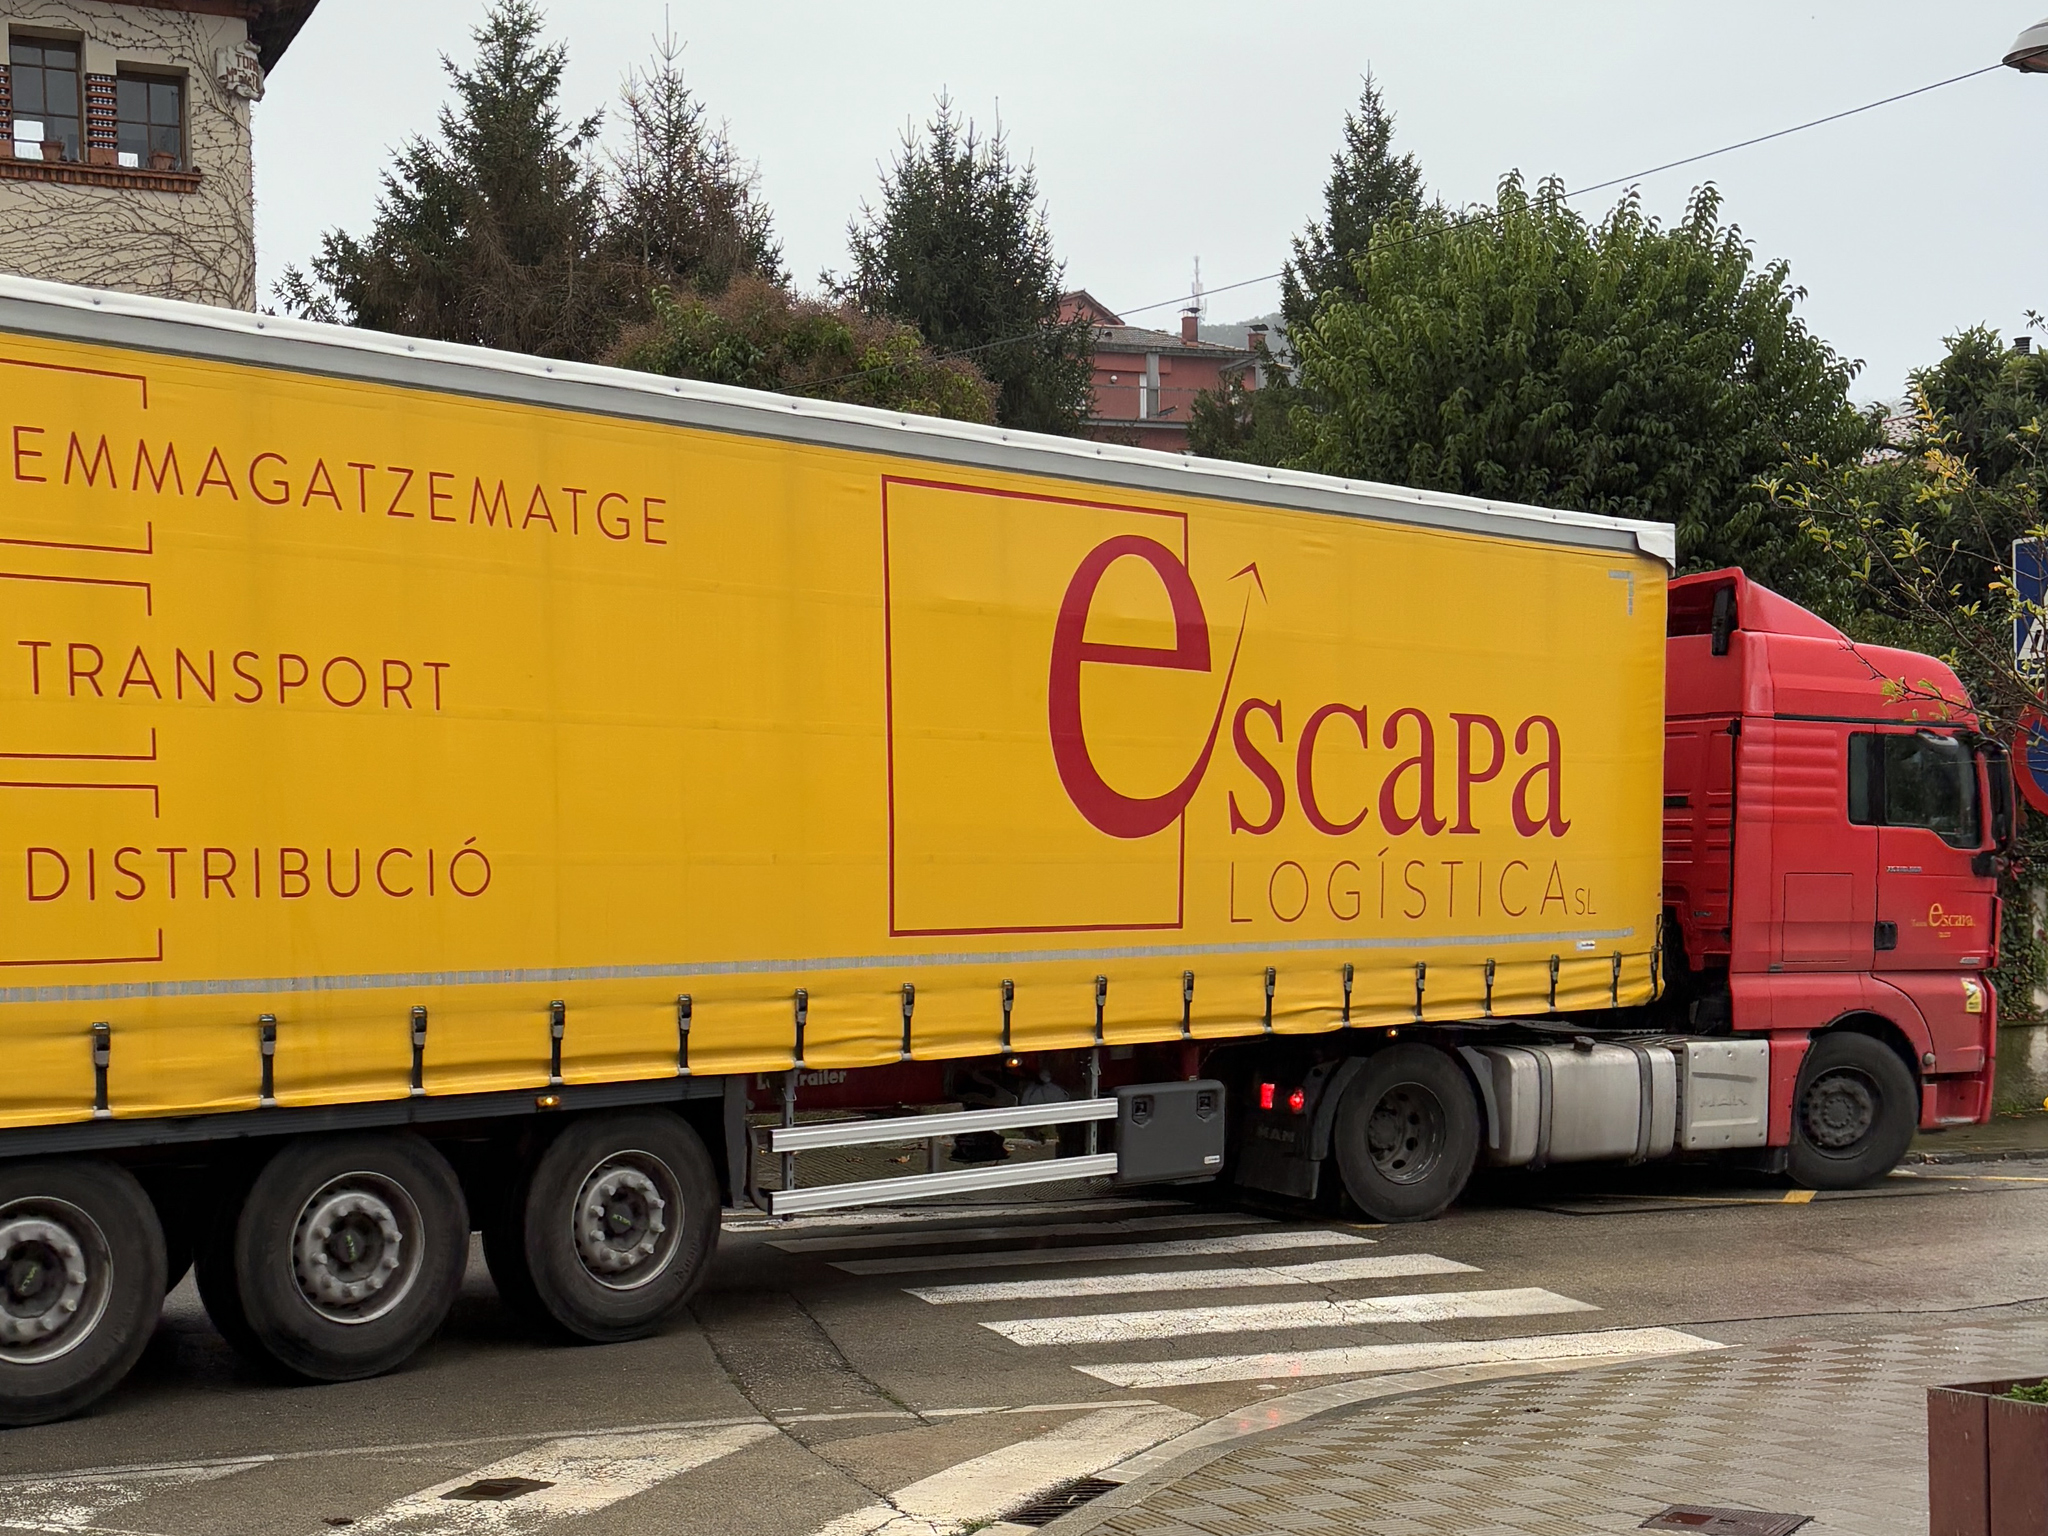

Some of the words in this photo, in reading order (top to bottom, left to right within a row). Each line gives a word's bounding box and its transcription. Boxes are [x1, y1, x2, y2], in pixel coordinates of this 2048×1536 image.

[13, 426, 667, 545] EMMAGATZEMATGE
[18, 640, 450, 711] TRANSPORT
[1048, 535, 1571, 839] escapa
[27, 836, 491, 902] DISTRIBUCIÓ
[1231, 847, 1568, 923] LOGÍSTICA
[1574, 887, 1597, 916] SL
